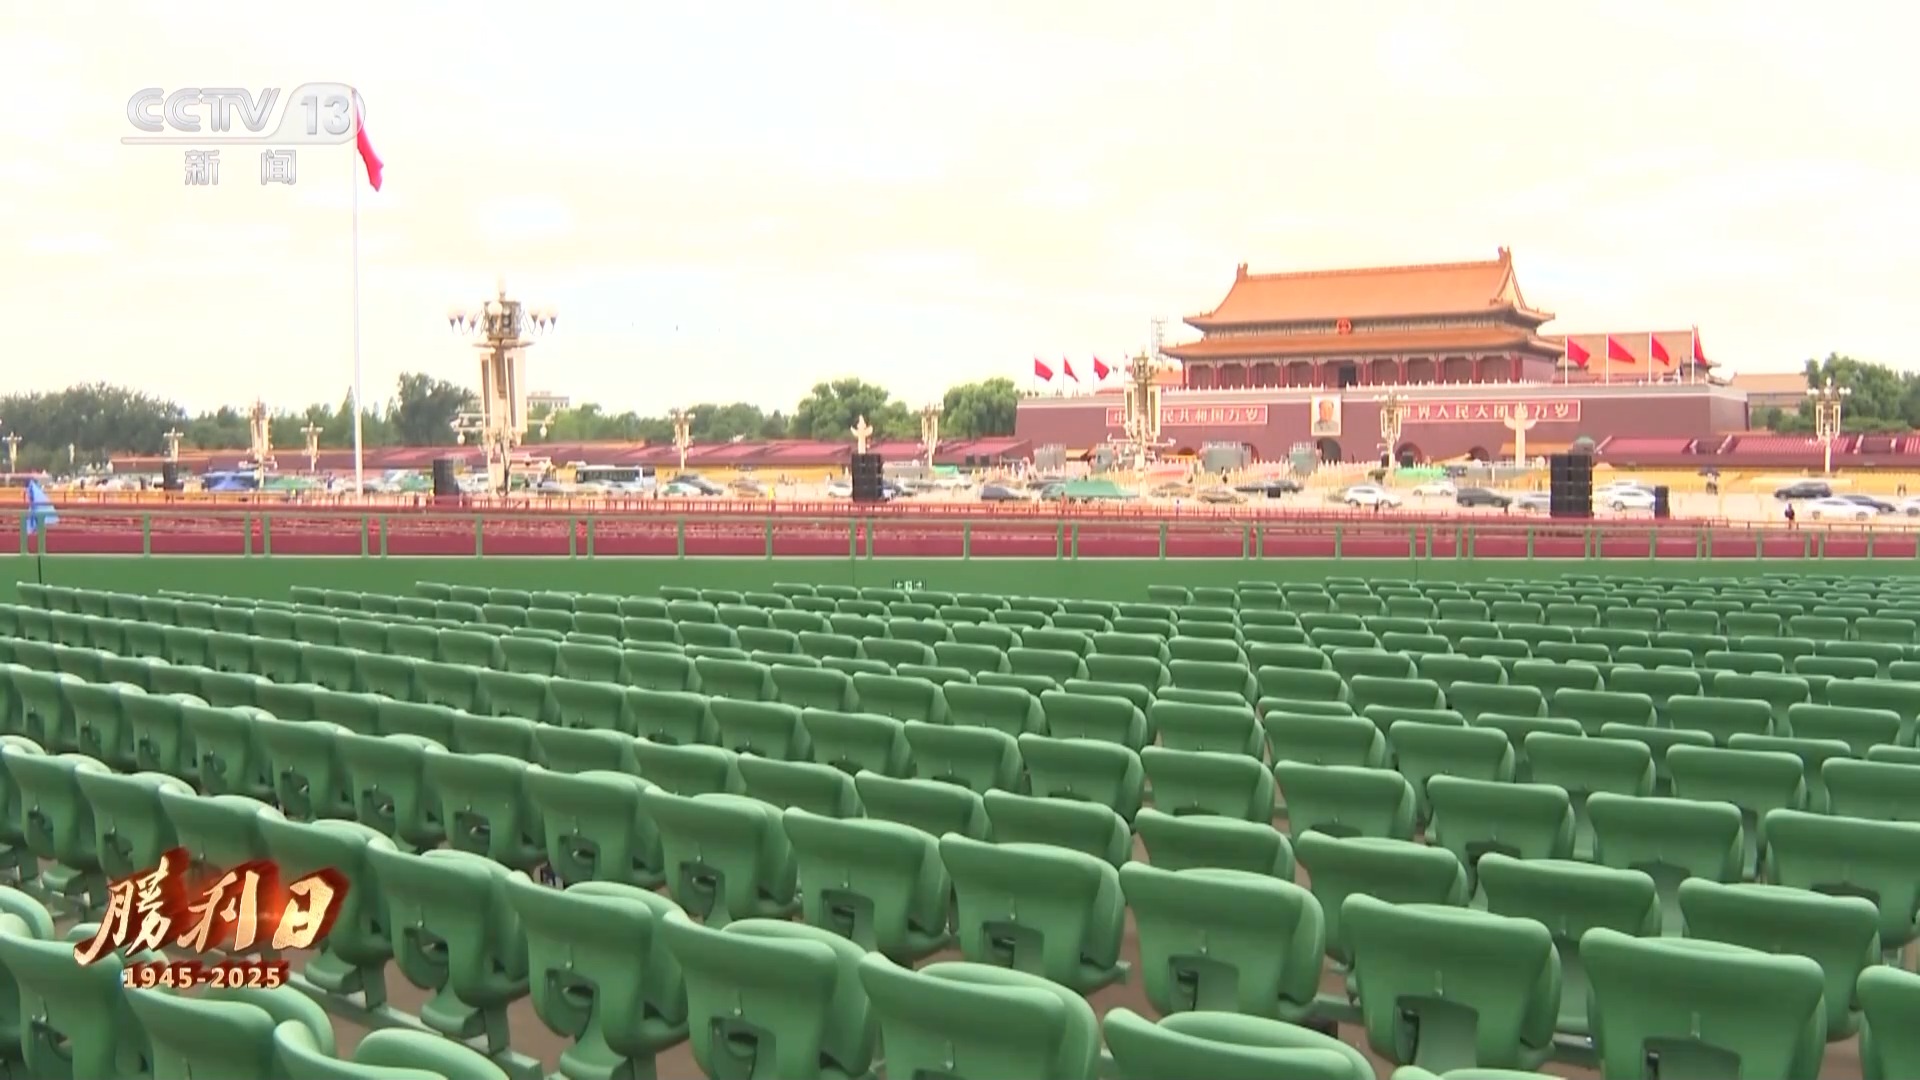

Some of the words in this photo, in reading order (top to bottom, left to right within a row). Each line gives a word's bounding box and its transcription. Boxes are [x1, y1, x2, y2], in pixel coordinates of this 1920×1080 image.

[1114, 407, 1258, 423] 中民共和国万岁
[1400, 403, 1568, 420] 世界人民大团万岁
